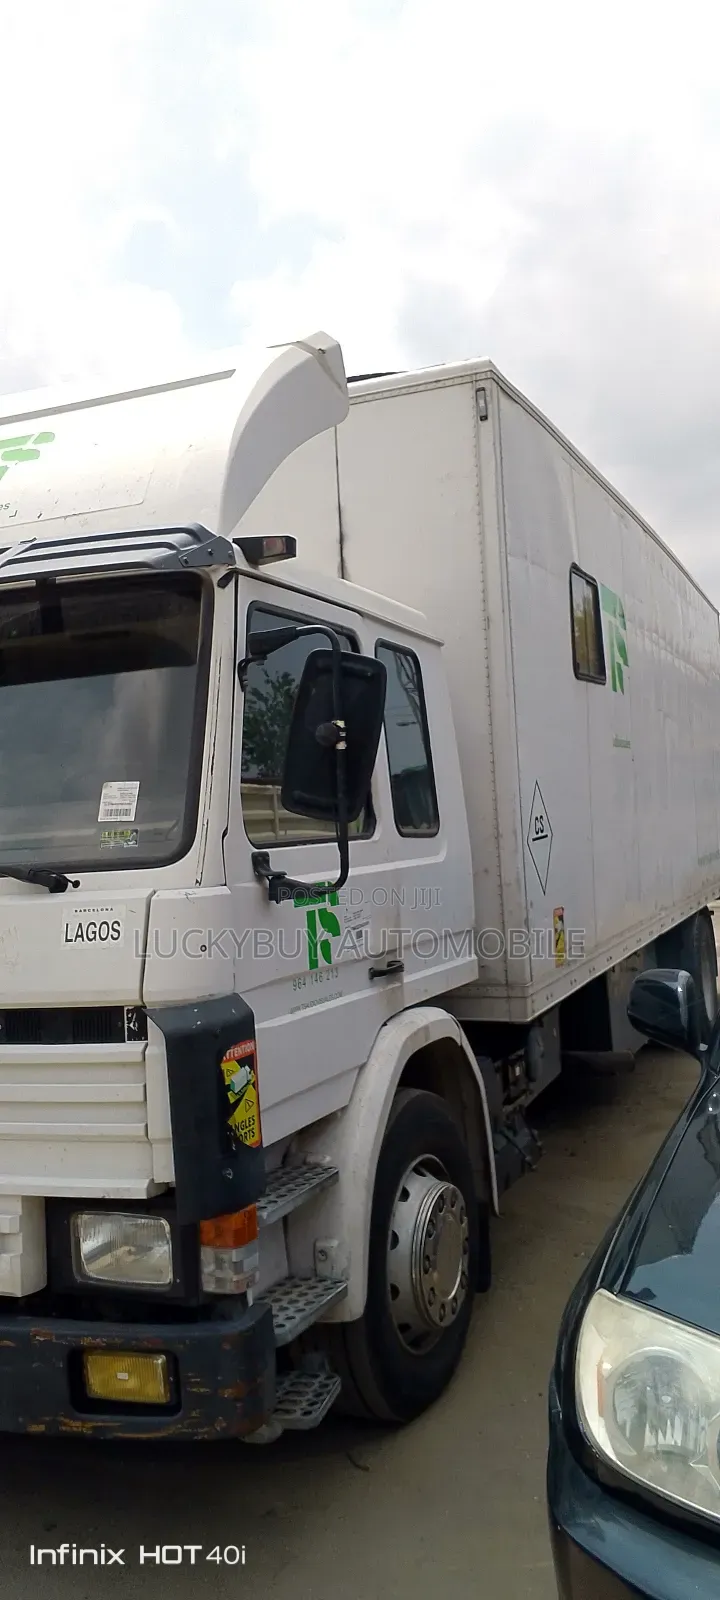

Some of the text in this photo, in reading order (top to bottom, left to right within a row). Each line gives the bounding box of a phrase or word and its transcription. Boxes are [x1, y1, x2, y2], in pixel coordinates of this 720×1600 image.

[534, 814, 545, 836] CS
[64, 920, 121, 943] LAGOS
[292, 967, 339, 991] 964 146 213
